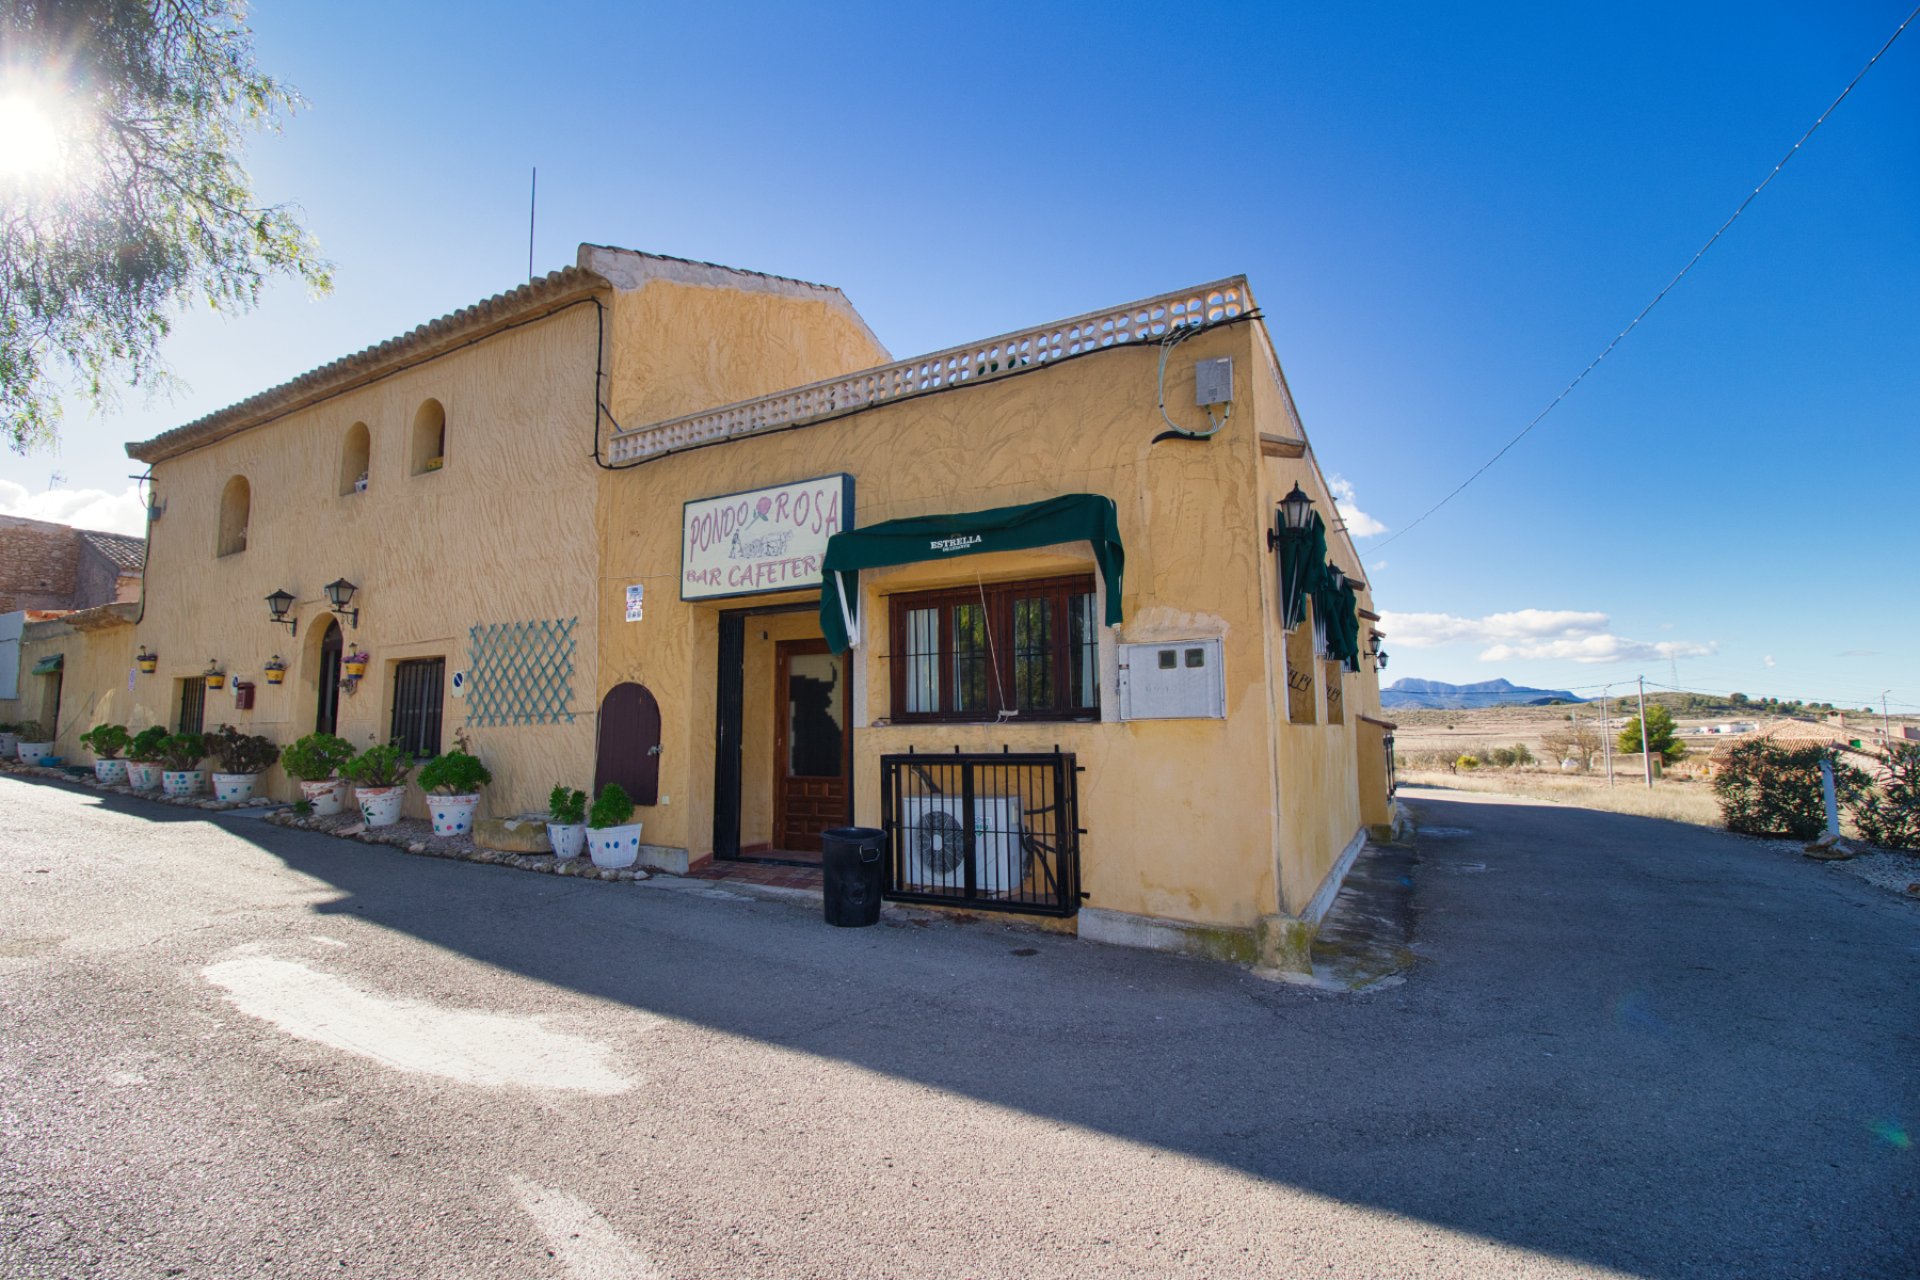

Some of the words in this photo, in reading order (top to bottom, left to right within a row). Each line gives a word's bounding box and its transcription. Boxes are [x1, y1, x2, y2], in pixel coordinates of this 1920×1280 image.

[690, 501, 749, 562] PONDO
[775, 489, 839, 538] ROSA
[930, 534, 982, 550] ESTRELLA
[686, 566, 722, 586] BAR
[727, 552, 824, 588] CAFETERI
